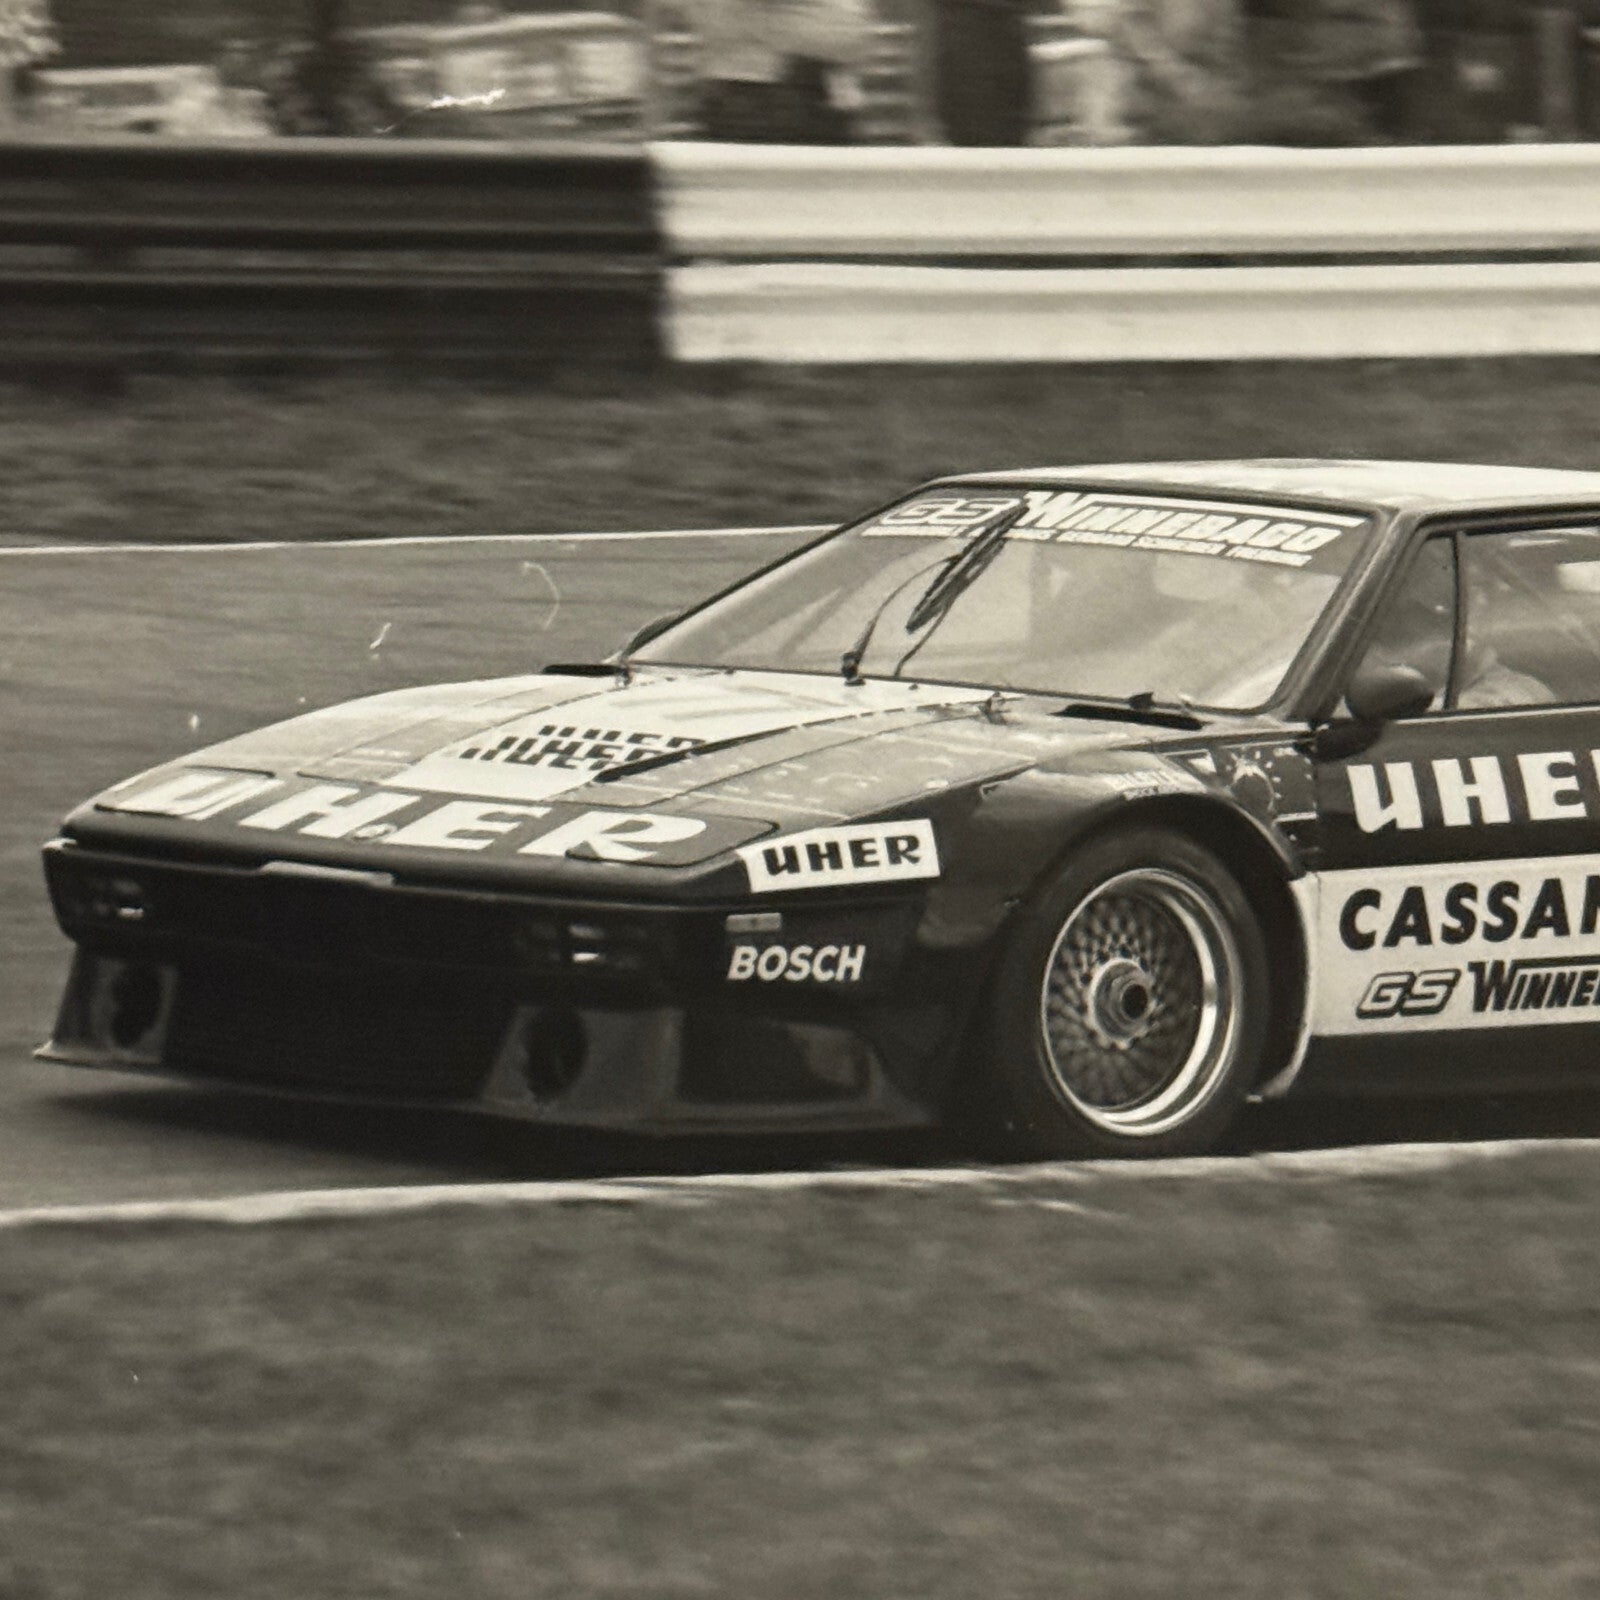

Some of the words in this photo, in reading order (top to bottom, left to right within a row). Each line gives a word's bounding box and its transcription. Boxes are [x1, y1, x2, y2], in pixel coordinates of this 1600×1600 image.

[1013, 491, 1367, 552] WINNEBAGO
[1346, 749, 1600, 833] UHE
[762, 835, 921, 877] UHER
[727, 945, 866, 982] BOSCH
[1356, 968, 1462, 1019] GS
[1468, 954, 1600, 1013] WINNE
